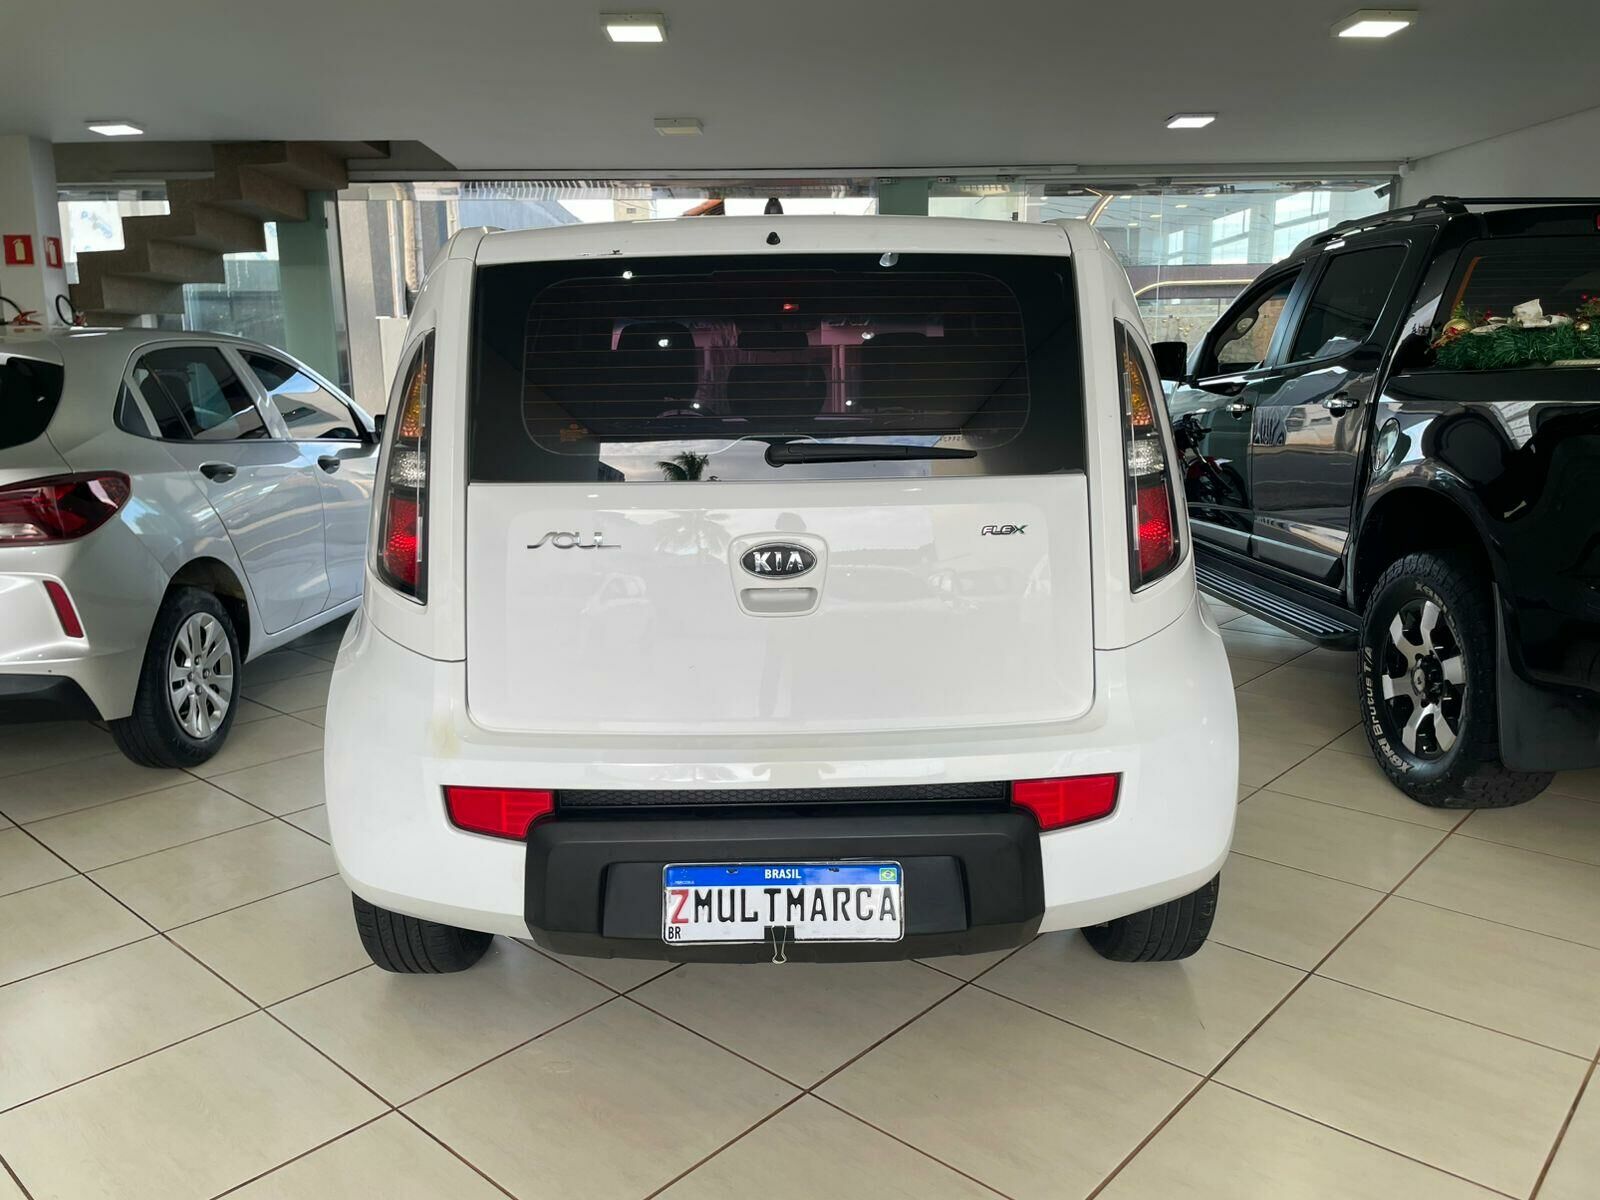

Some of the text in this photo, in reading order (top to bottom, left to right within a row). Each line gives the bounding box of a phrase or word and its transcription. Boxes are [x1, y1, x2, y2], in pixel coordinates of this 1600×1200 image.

[981, 524, 1028, 536] FLEX
[526, 531, 621, 549] SOUL
[753, 551, 804, 572] KIA
[1364, 646, 1373, 672] T/A
[1366, 677, 1383, 736] Brutus
[764, 869, 802, 880] BRASIL
[668, 926, 682, 940] BR
